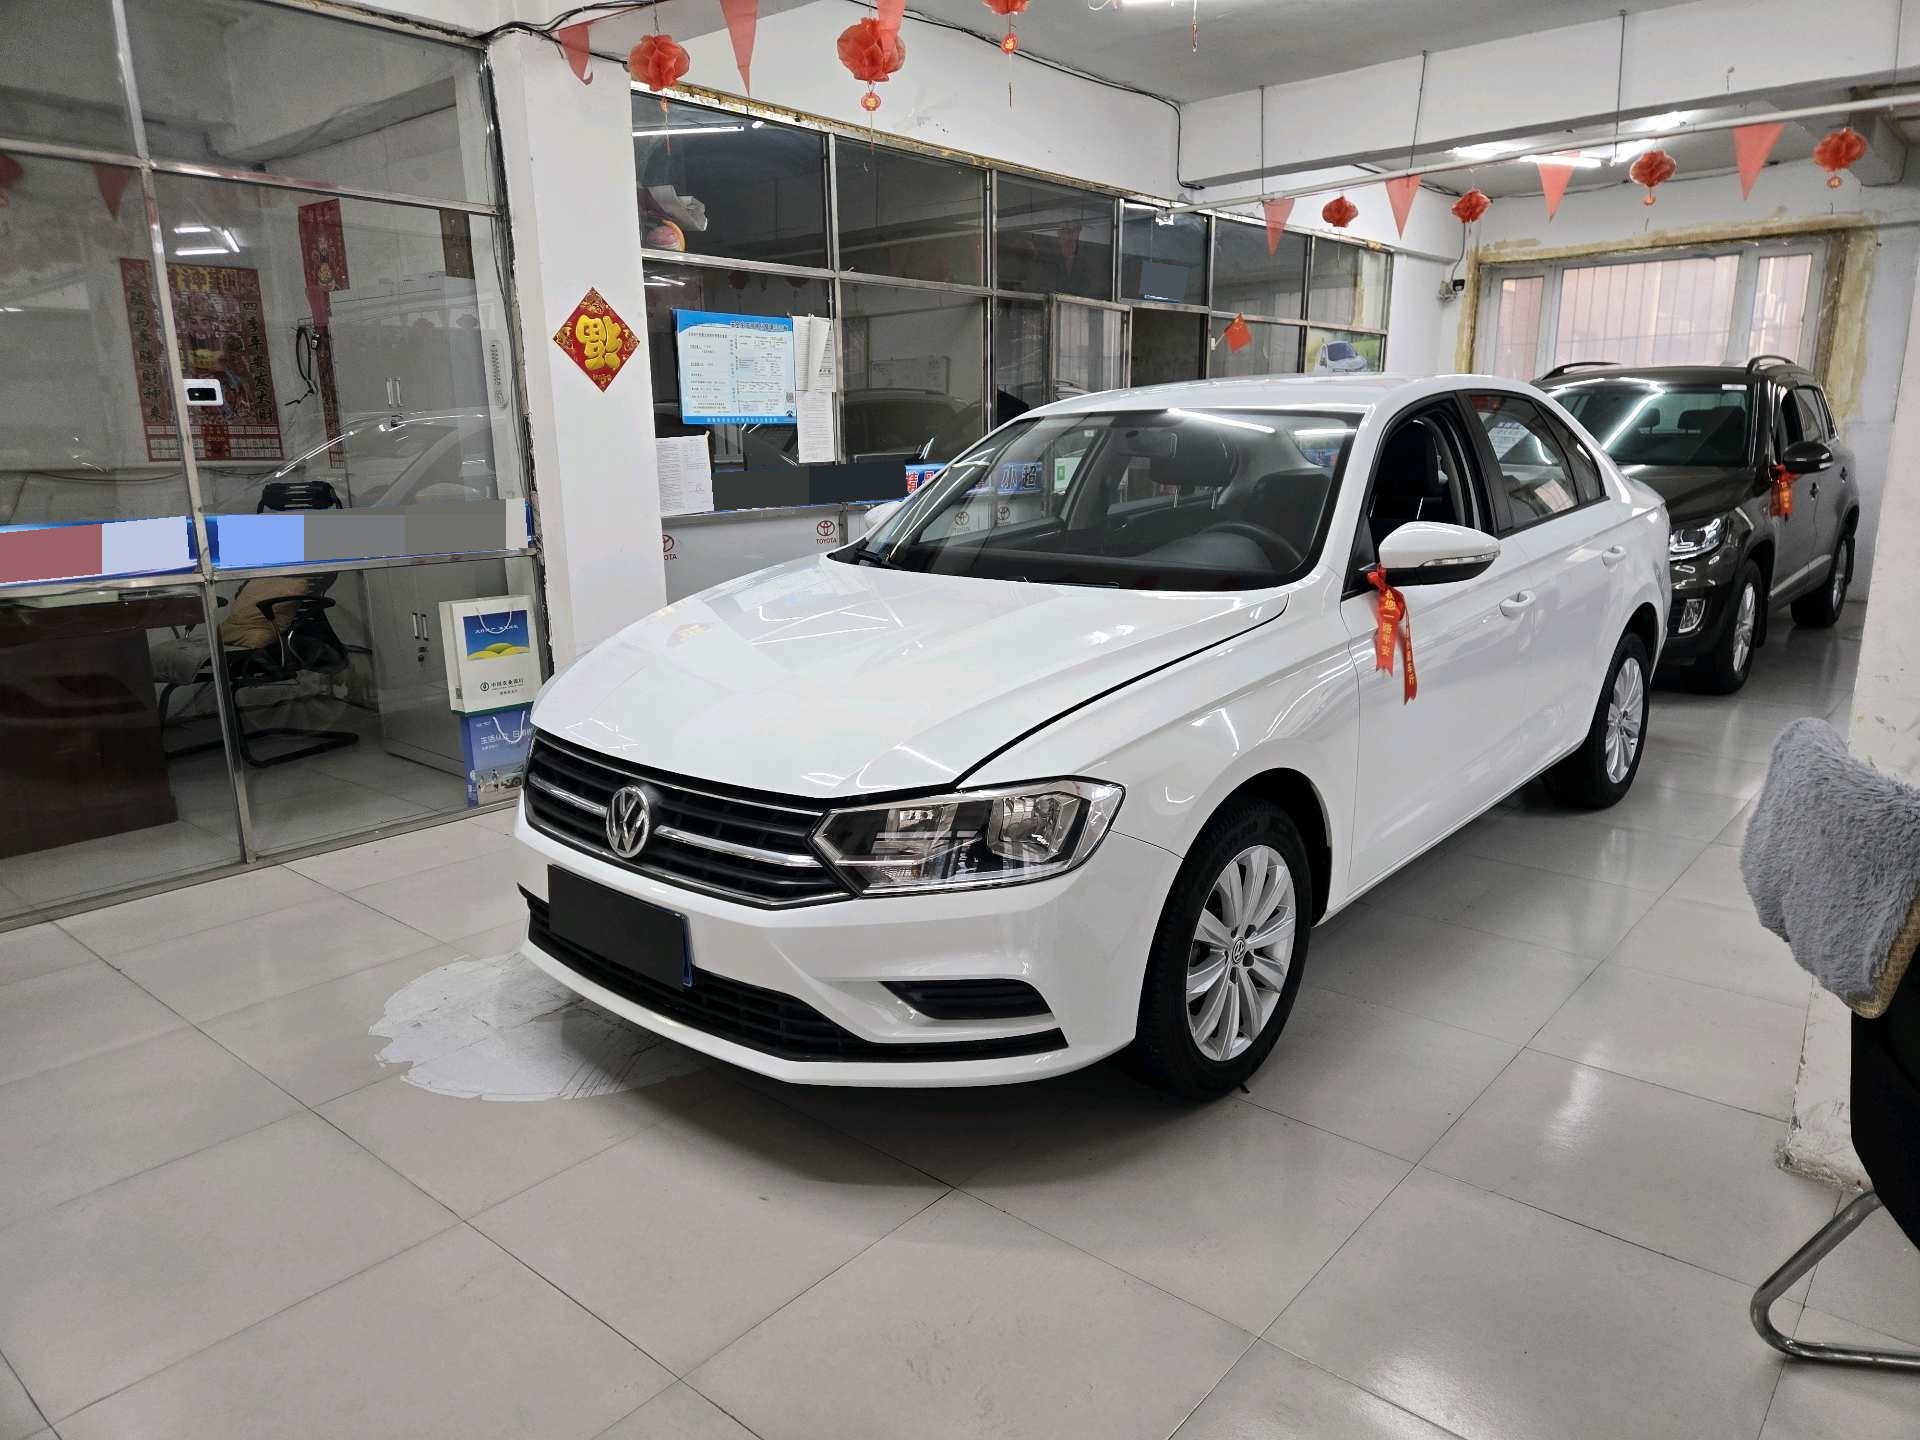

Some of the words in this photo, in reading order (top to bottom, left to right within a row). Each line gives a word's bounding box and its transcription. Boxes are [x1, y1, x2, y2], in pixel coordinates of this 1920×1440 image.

[576, 315, 622, 370] 福
[491, 678, 524, 688] 中国农业银行
